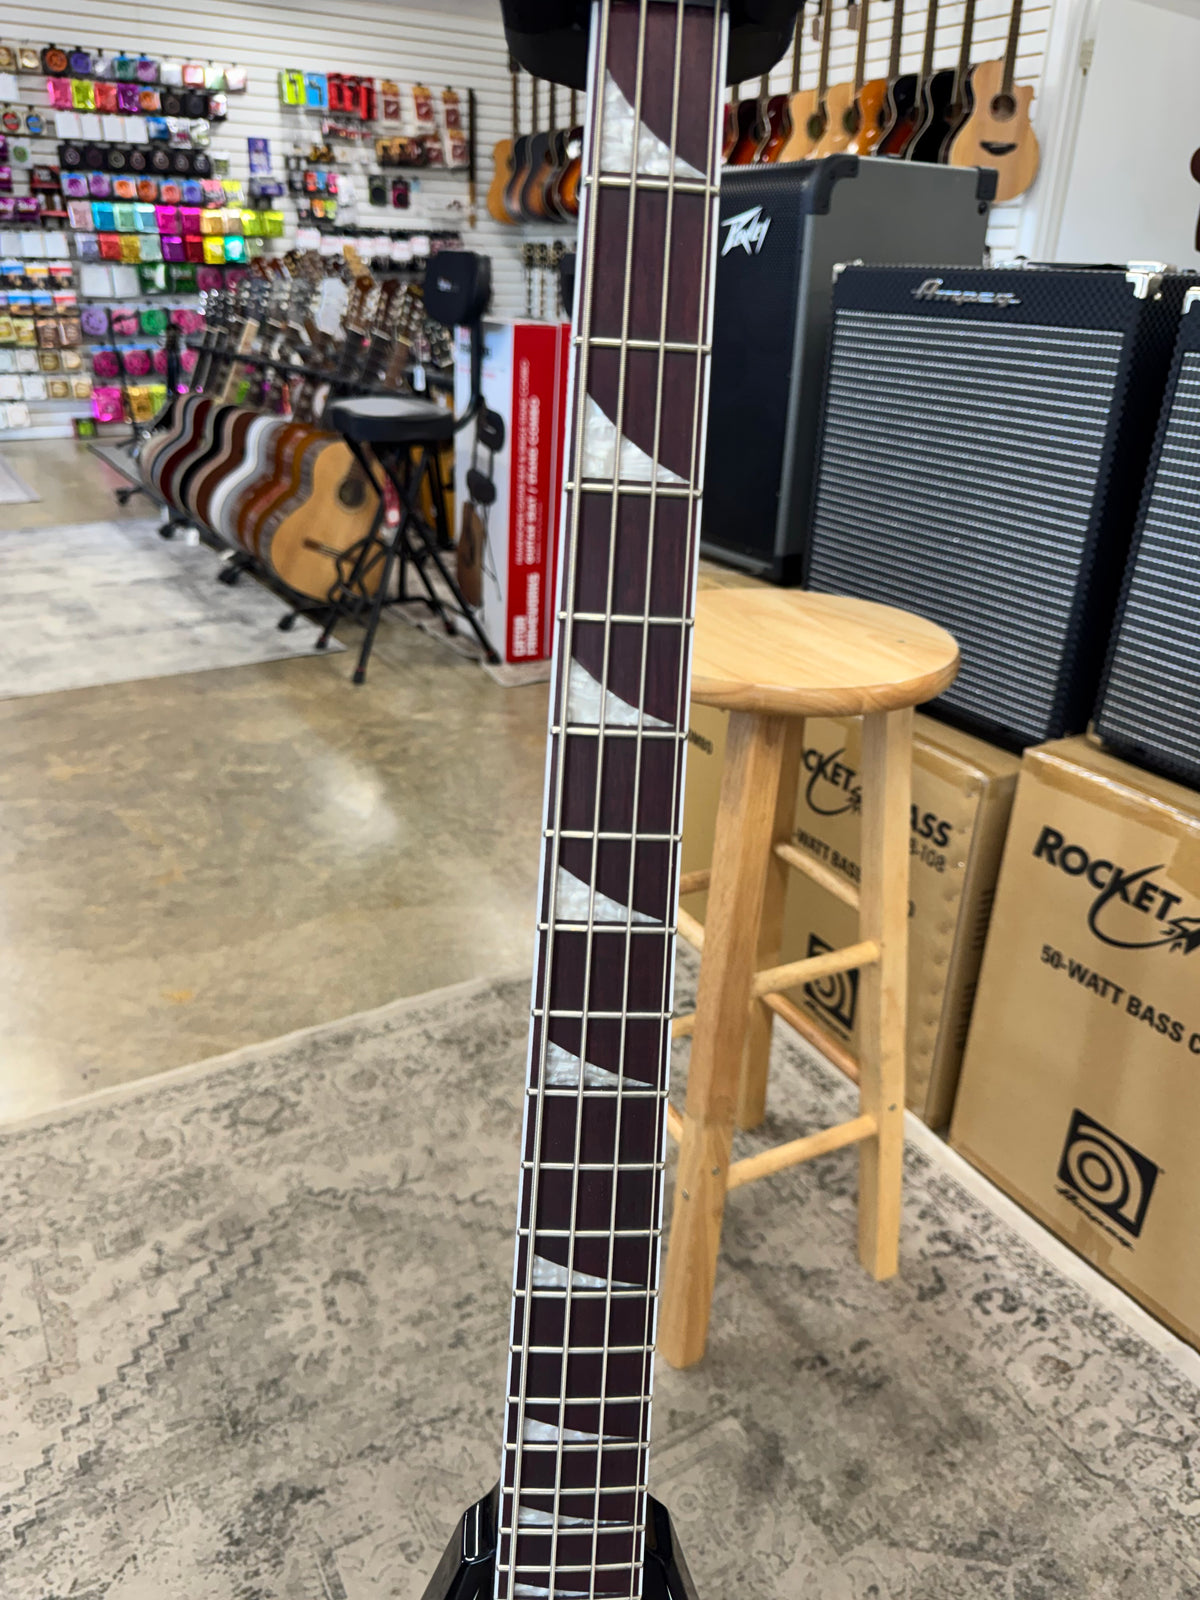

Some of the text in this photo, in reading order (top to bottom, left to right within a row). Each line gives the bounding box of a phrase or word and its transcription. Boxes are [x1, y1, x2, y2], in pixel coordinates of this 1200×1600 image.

[911, 278, 1021, 308] Ampeg
[802, 748, 857, 815] CKET
[1032, 825, 1182, 949] ROCKET
[1041, 944, 1125, 1005] 50-WATT
[1126, 994, 1185, 1043] BASS
